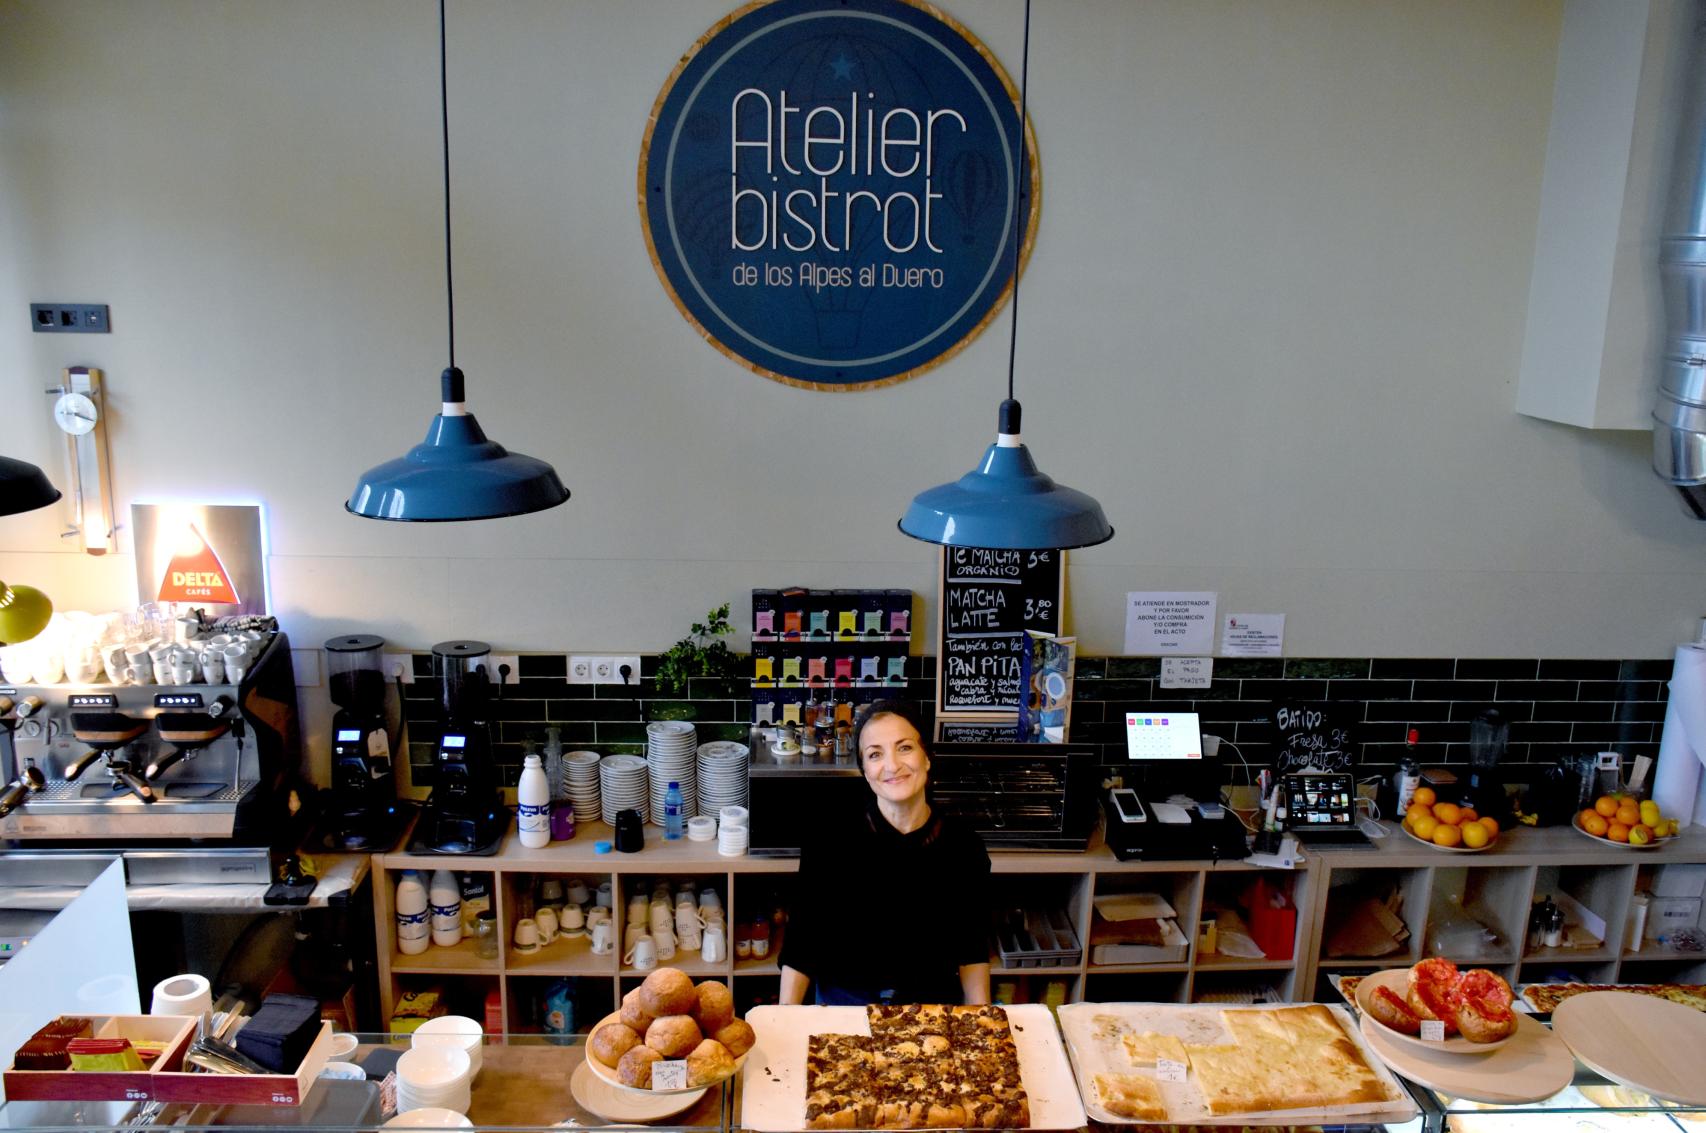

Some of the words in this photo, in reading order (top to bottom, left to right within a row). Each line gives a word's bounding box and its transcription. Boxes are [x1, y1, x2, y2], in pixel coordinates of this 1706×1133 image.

[732, 88, 967, 177] Atelier
[732, 175, 943, 254] bistrot
[732, 262, 758, 287] de
[764, 262, 793, 287] los
[799, 262, 852, 294] Alpes
[859, 263, 875, 288] al
[882, 263, 944, 289] Duero
[173, 572, 223, 587] DELTA
[950, 587, 1006, 608] MATCHA
[950, 607, 1000, 628] LATTE
[948, 656, 976, 677] PAN
[949, 676, 989, 691] aguacate
[990, 678, 996, 689] y
[1287, 732, 1328, 751] Fresa
